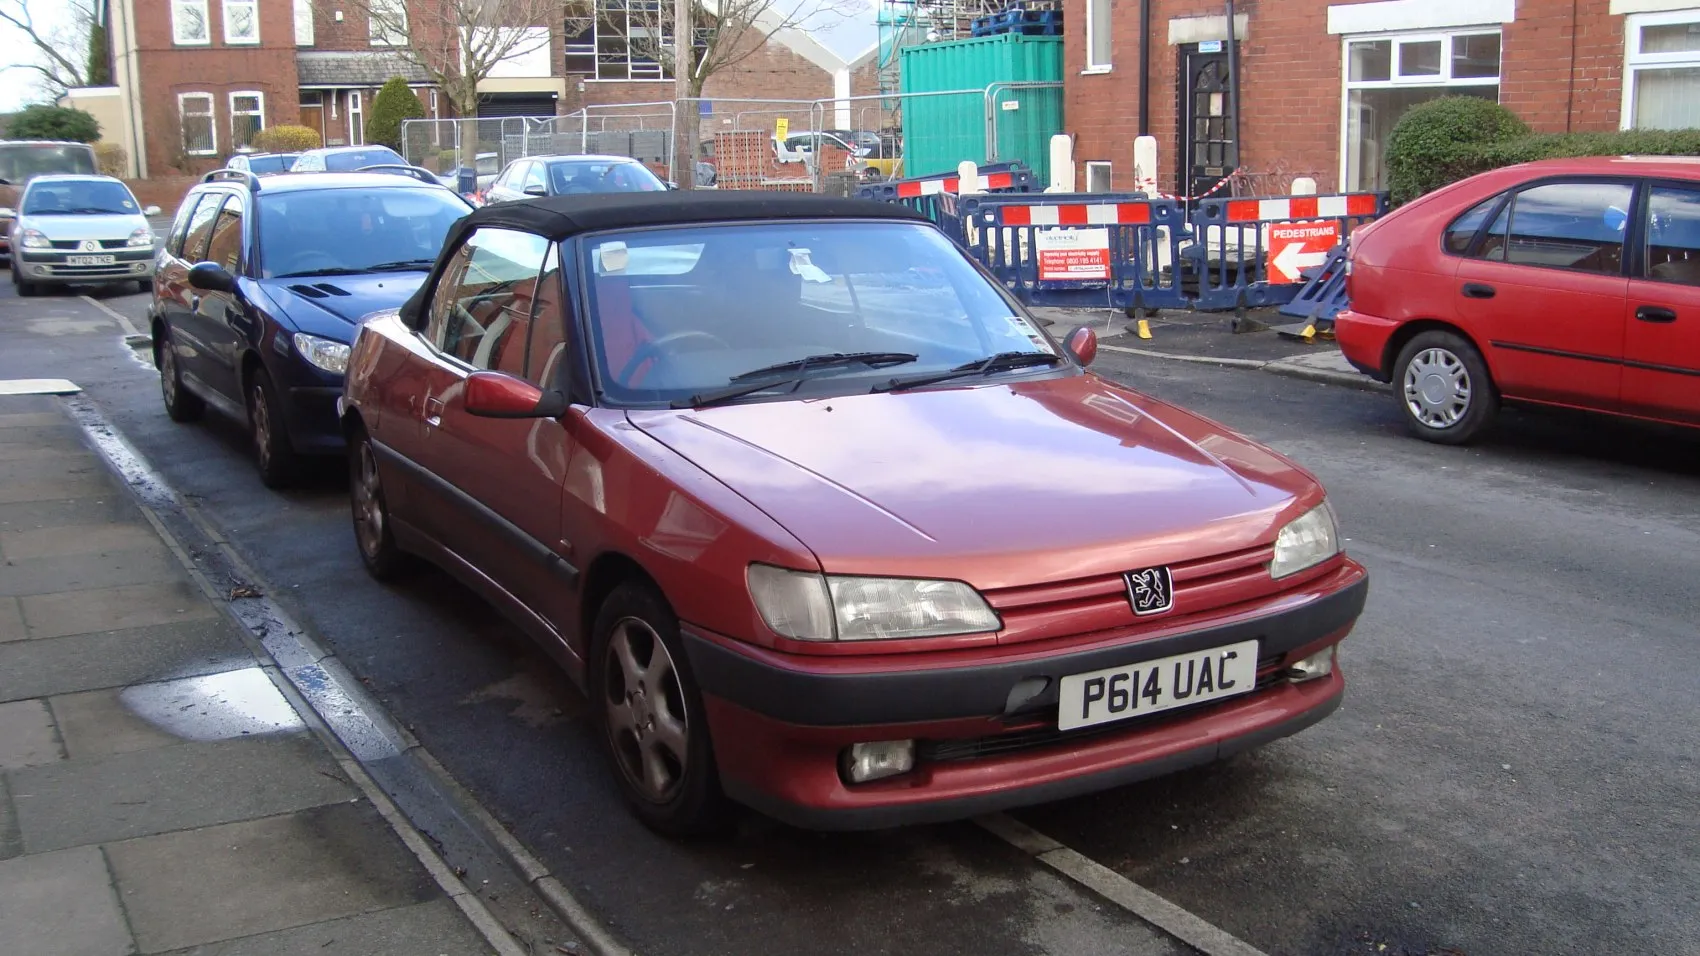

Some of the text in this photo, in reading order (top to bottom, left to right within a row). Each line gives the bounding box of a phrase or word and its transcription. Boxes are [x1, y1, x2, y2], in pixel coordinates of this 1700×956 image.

[1273, 226, 1334, 239] PEDESTRIANS
[1082, 651, 1238, 719] P614 UAC
